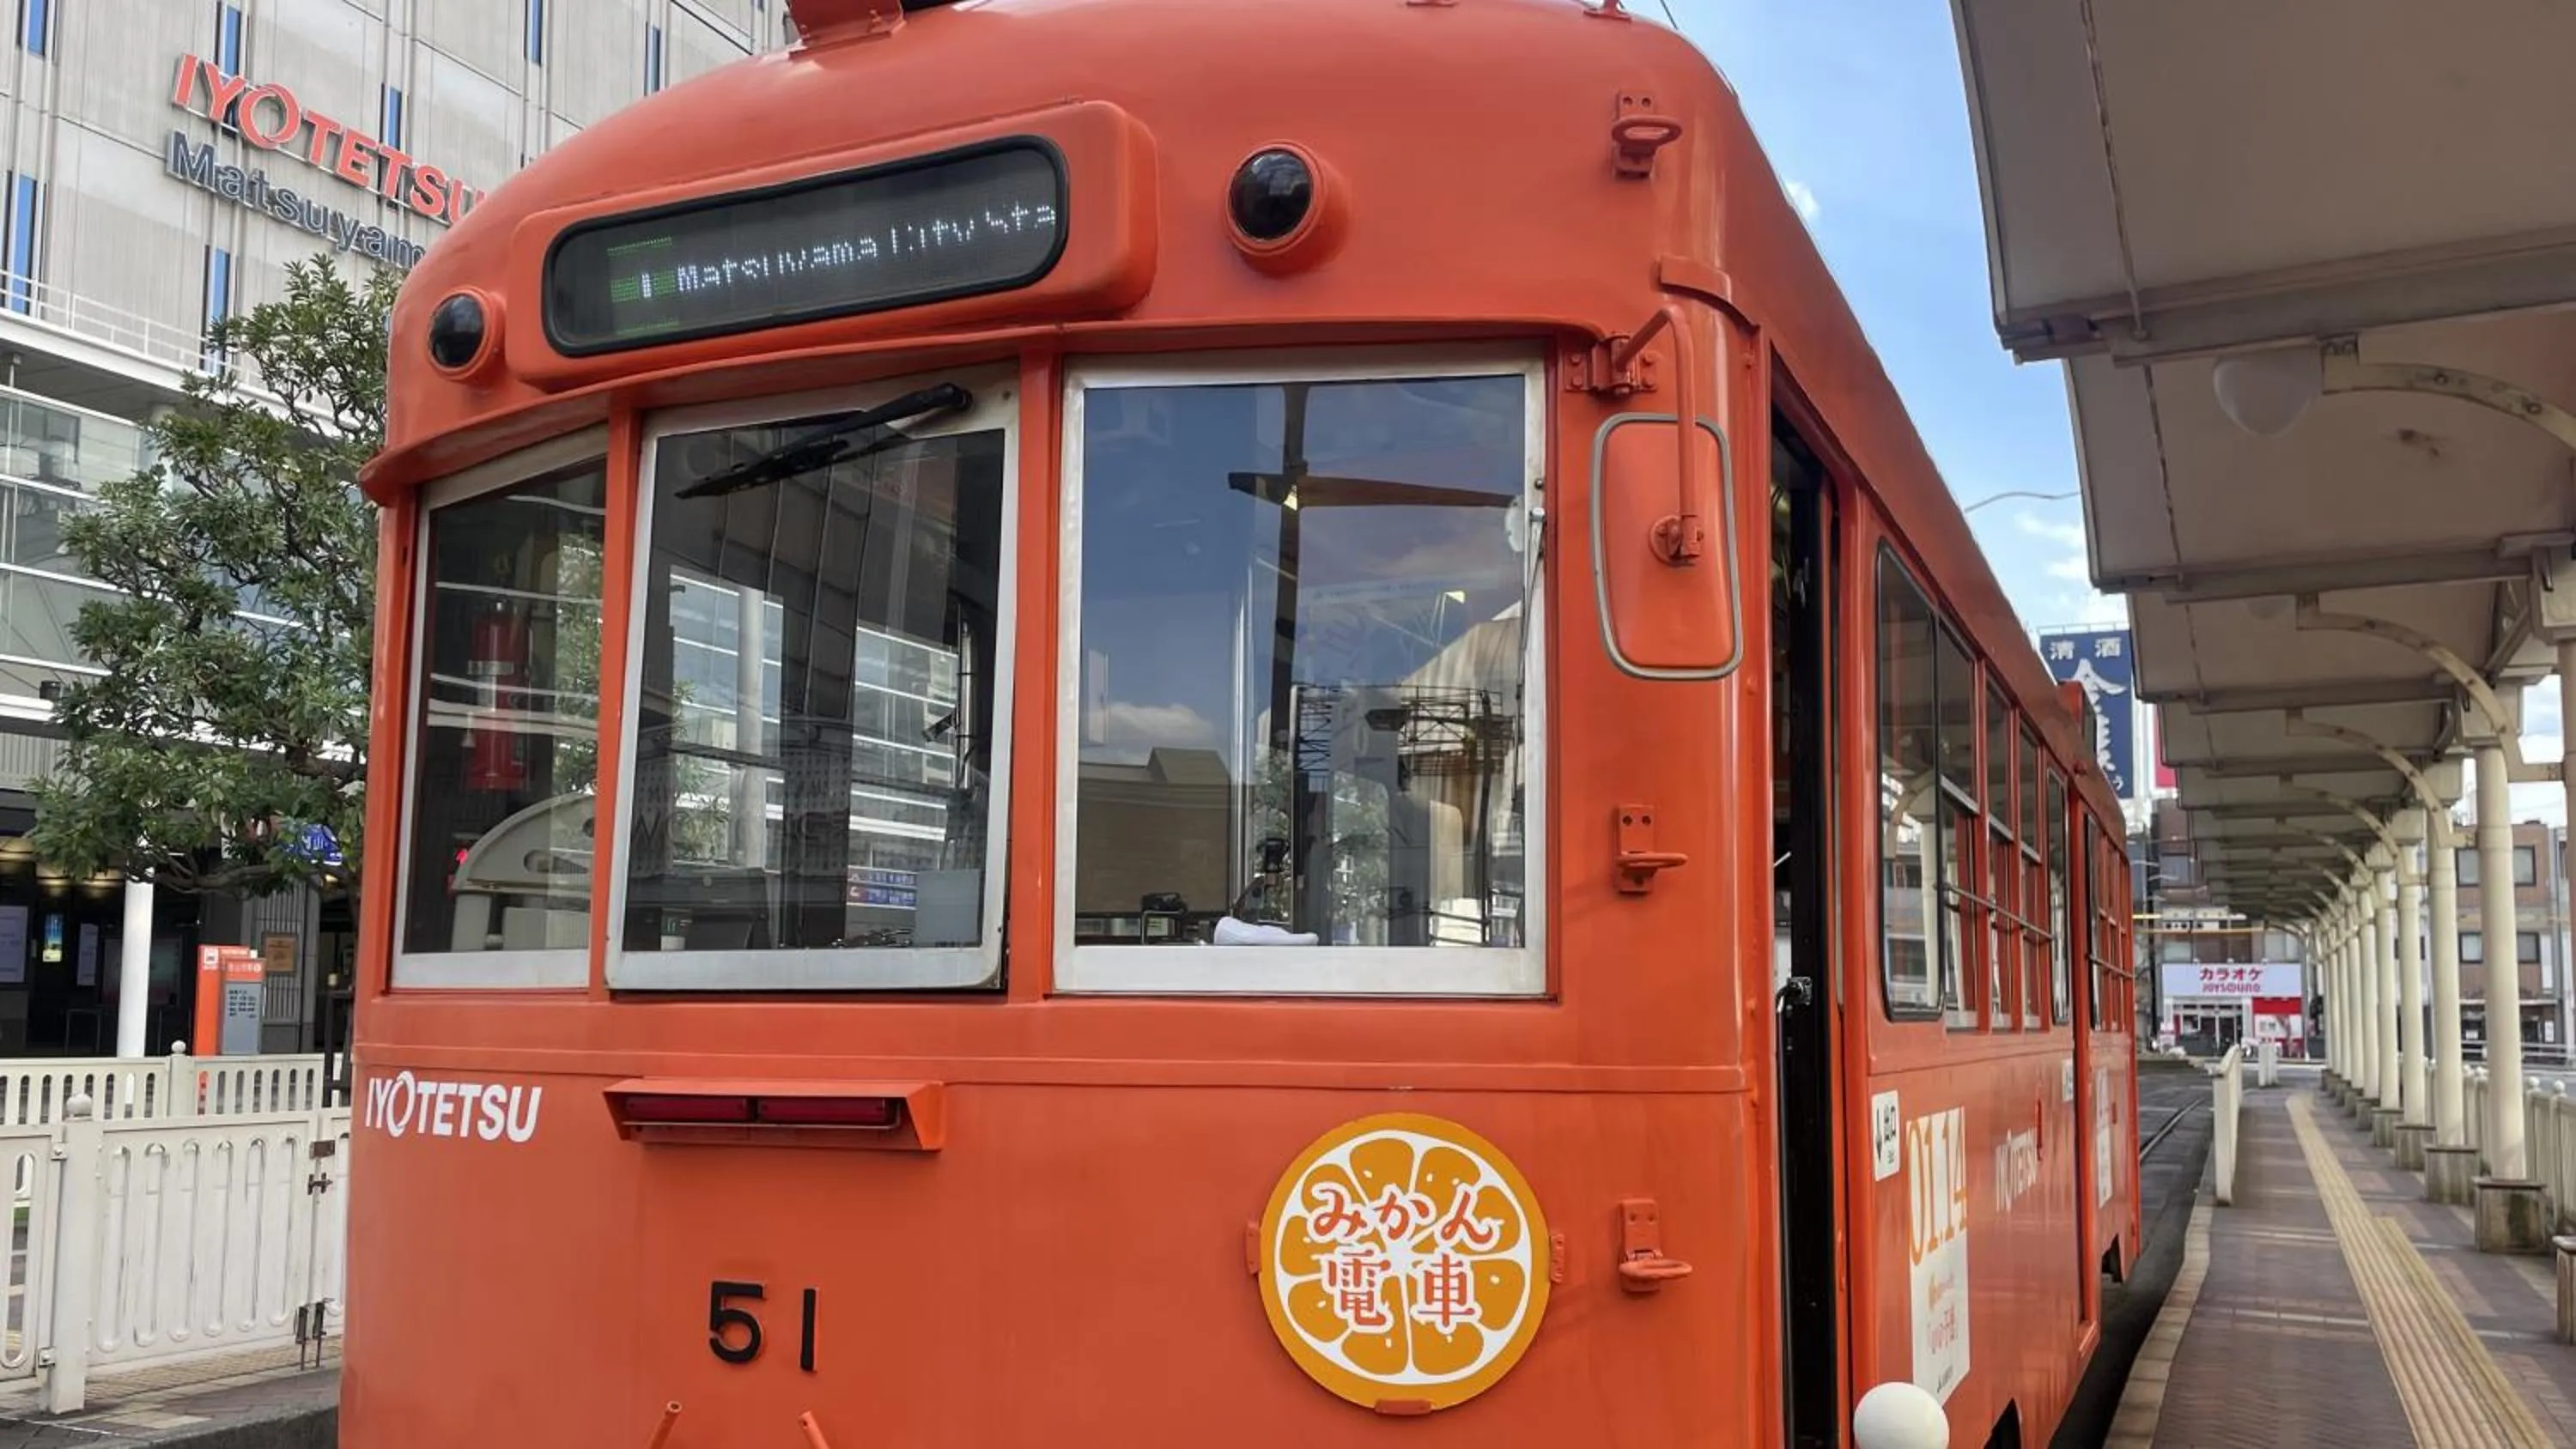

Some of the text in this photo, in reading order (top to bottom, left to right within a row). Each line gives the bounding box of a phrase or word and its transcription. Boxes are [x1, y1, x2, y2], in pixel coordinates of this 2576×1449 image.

[677, 236, 878, 293] Matsuyama
[2049, 637, 2122, 661] 清酒
[2199, 967, 2263, 981] カラオケ
[365, 1070, 543, 1143] IYOTETSU
[1309, 1184, 1498, 1246] みかん
[1324, 1246, 1479, 1330] 電車
[709, 1280, 817, 1373] 51
